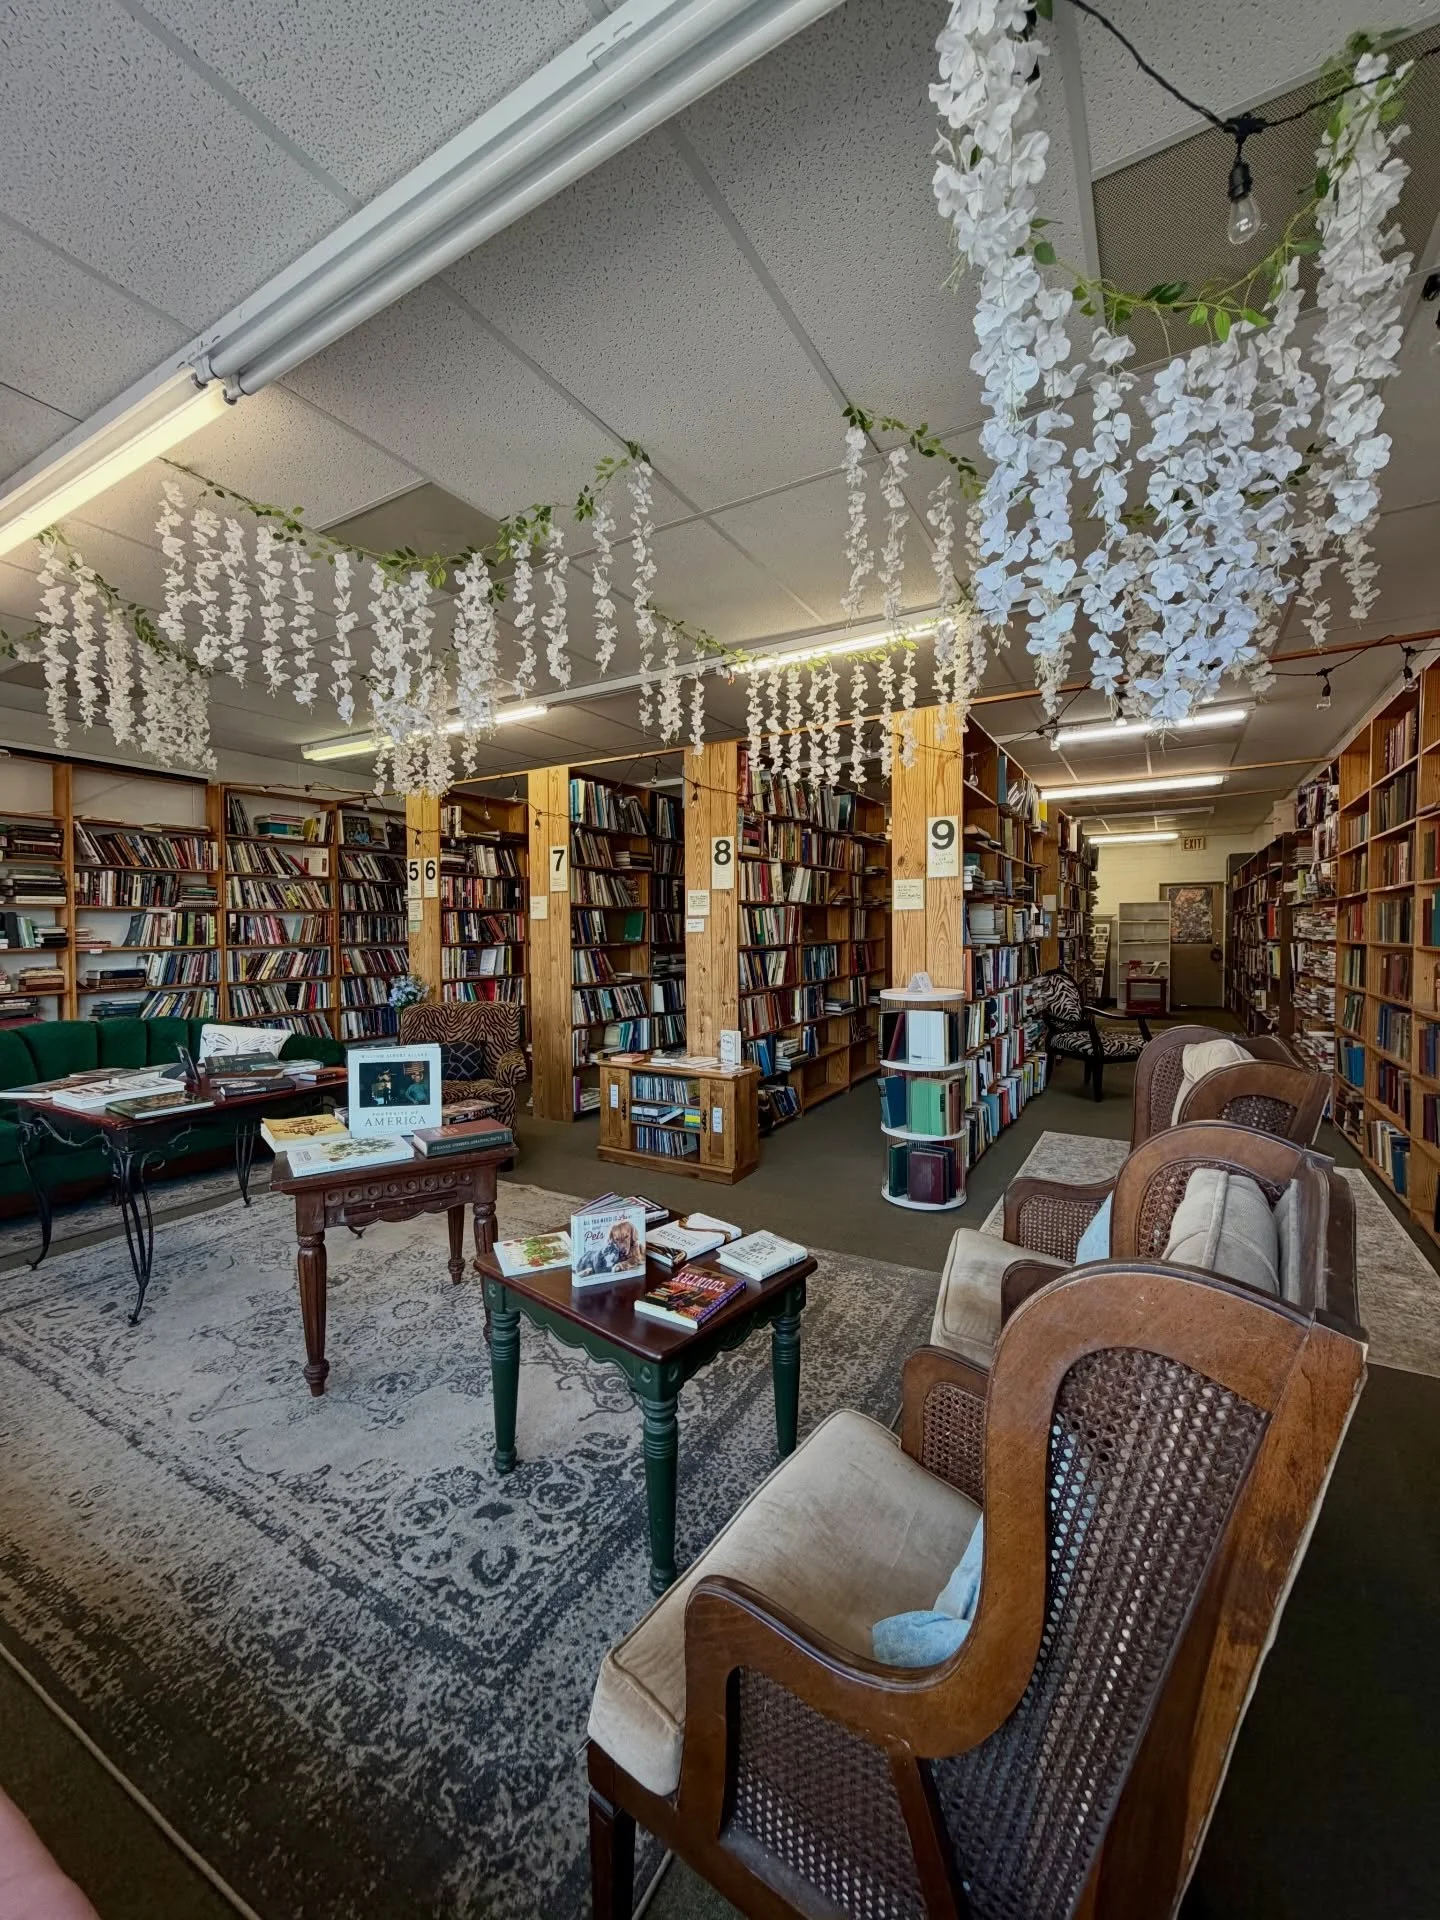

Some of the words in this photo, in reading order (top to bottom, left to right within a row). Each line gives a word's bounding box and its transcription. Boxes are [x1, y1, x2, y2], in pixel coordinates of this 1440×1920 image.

[931, 819, 955, 850] 9
[1183, 838, 1202, 850] EXIT
[552, 849, 565, 872] 7
[713, 839, 732, 866] 8
[408, 861, 420, 881] 5
[425, 860, 436, 880] 6
[364, 1115, 427, 1127] AMERICA
[584, 1230, 605, 1241] Pets
[672, 1272, 726, 1293] COUNTRY
